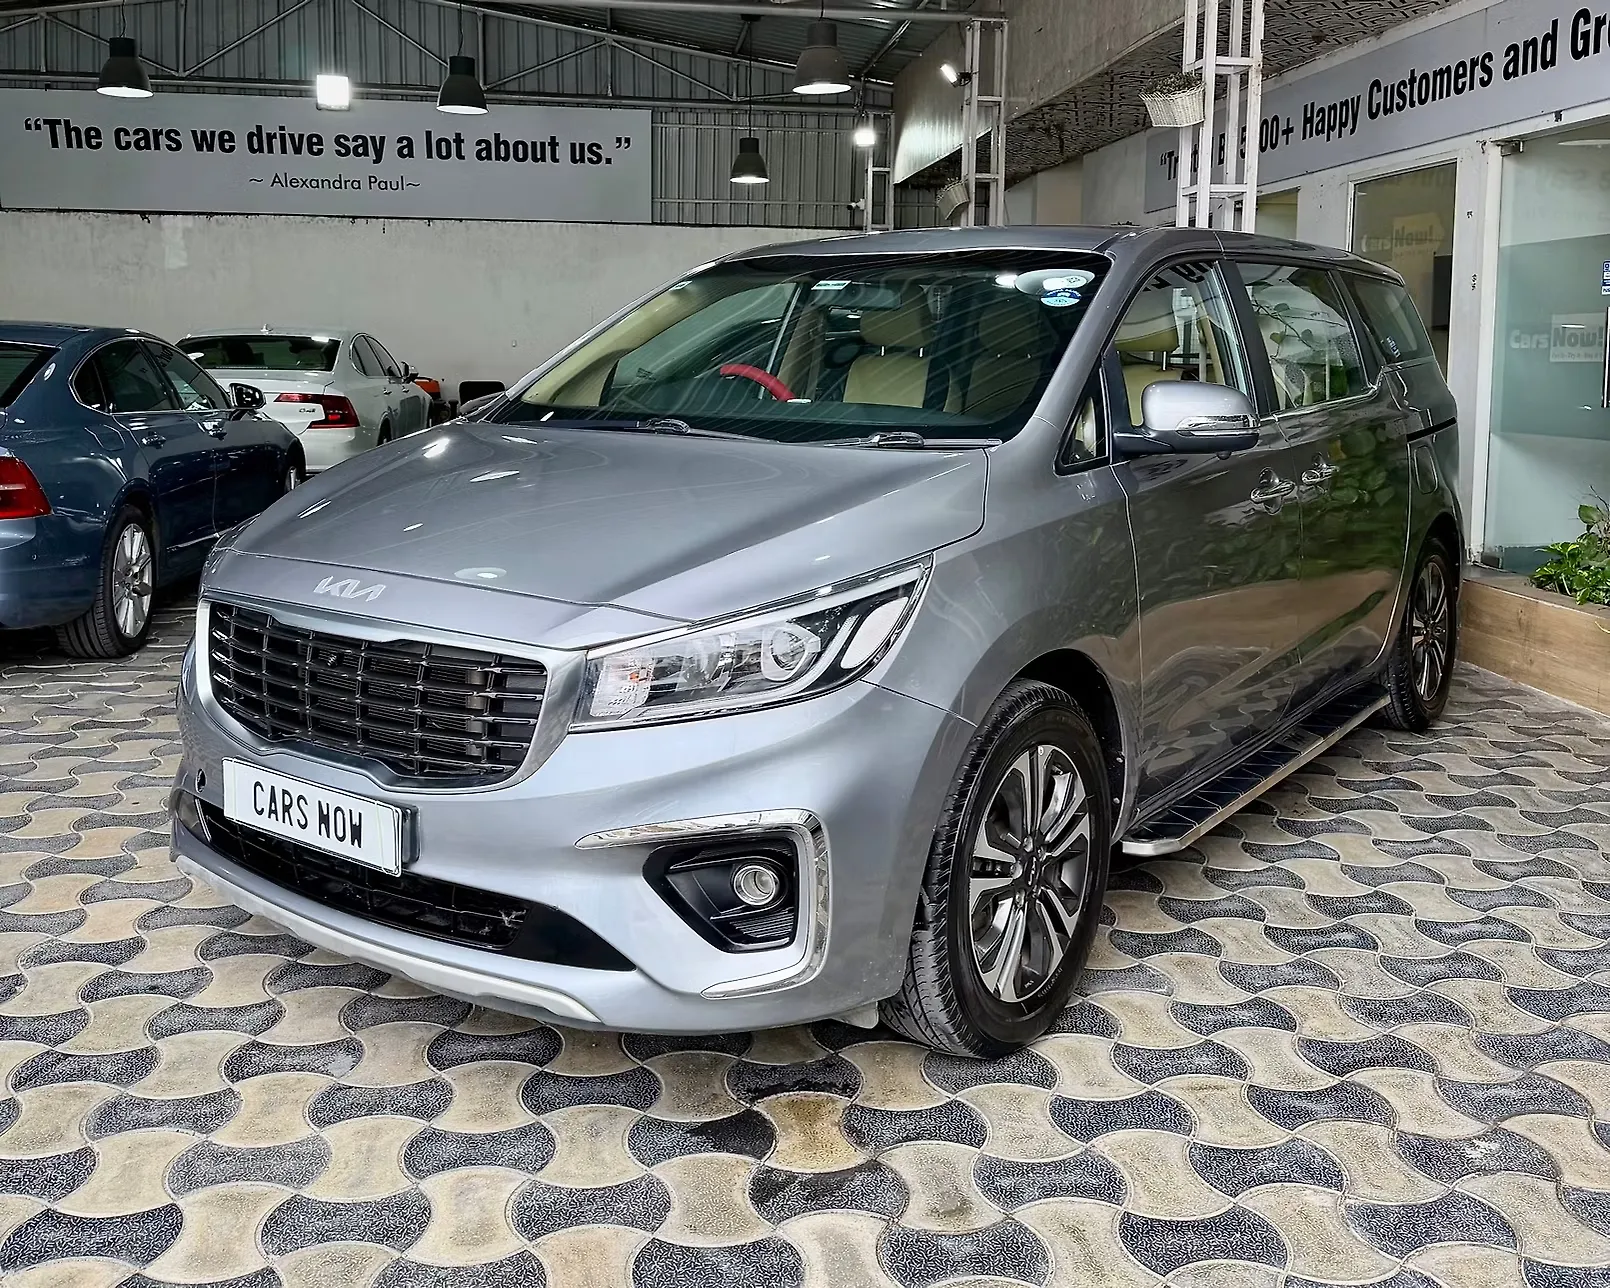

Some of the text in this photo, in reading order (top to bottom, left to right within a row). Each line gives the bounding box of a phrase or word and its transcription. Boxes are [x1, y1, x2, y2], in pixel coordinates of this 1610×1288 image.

[1301, 94, 1362, 142] Happy
[1366, 51, 1494, 121] Customers
[1502, 18, 1559, 81] and
[1570, 7, 1610, 61] Gr
[113, 126, 183, 152] cars
[190, 129, 237, 154] we
[246, 124, 325, 157] drive
[334, 133, 386, 165] say
[396, 135, 415, 159] a
[425, 130, 466, 160] lot
[475, 132, 560, 164] about
[270, 172, 362, 190] Alexandra
[1509, 329, 1550, 349] Cars
[313, 576, 387, 601] KIA
[253, 781, 363, 849] CARS NOW
